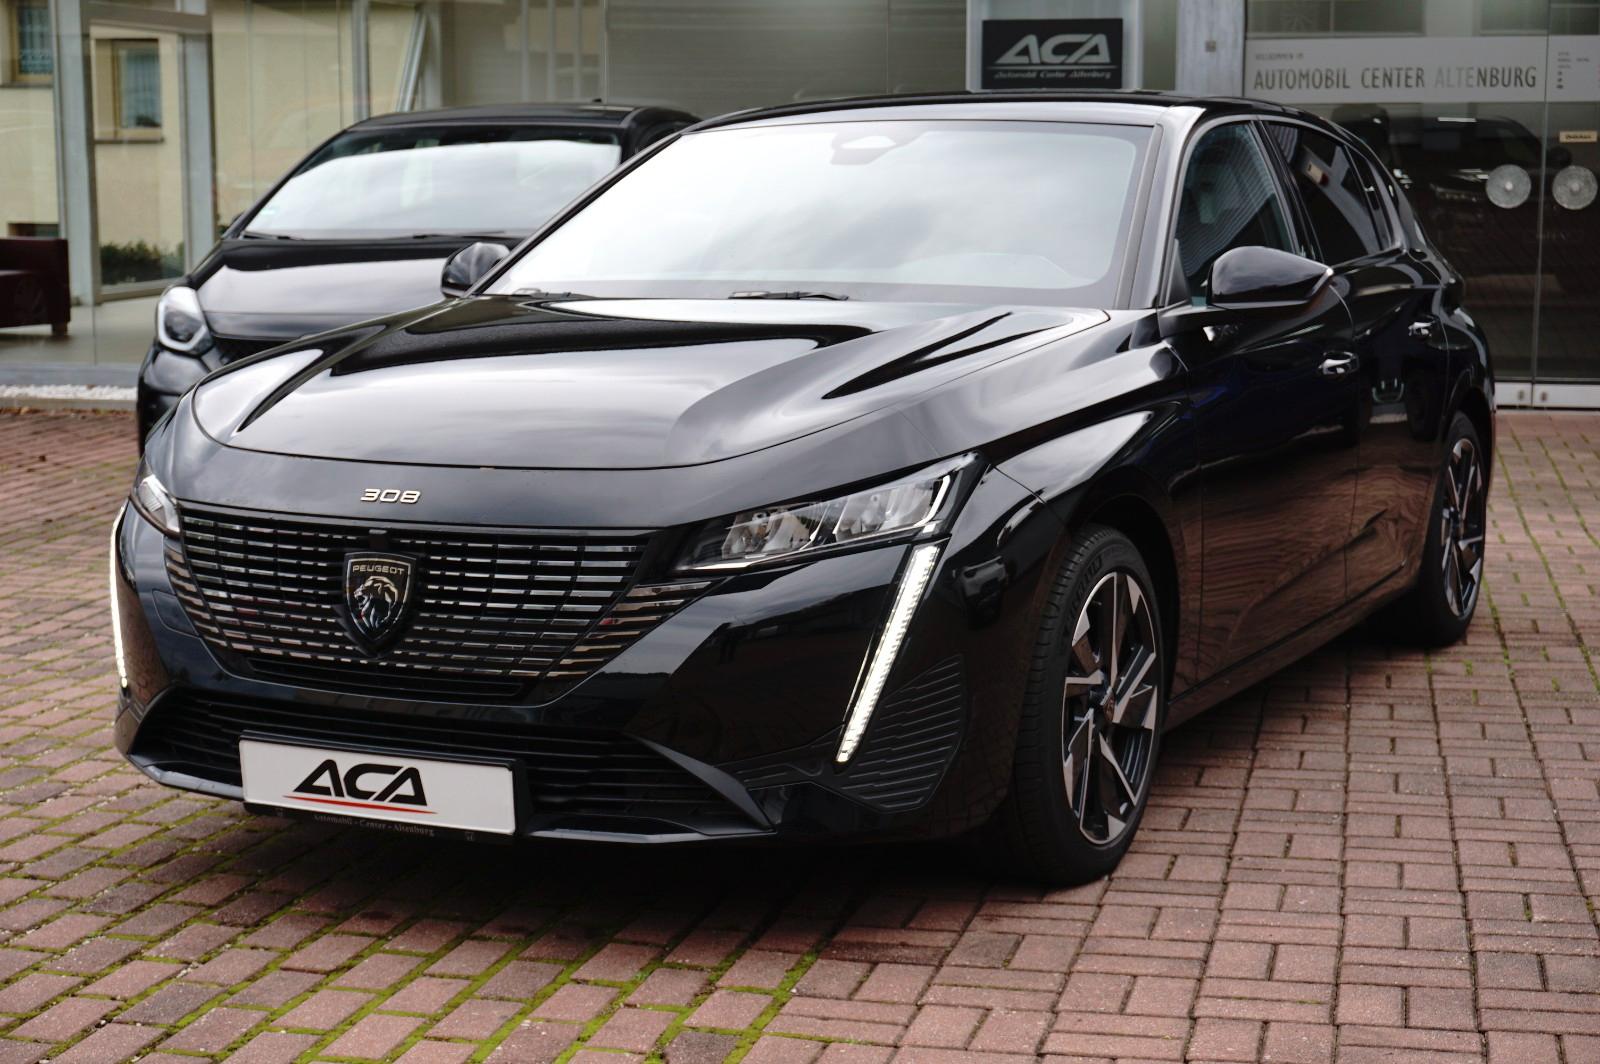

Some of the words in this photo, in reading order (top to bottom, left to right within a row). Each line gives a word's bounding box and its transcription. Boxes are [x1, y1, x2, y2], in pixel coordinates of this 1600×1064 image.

[994, 33, 1112, 65] ACA
[1254, 67, 1351, 90] AUTOMOBIL
[1361, 66, 1425, 89] CENTER
[1434, 66, 1537, 89] ALTENBURG
[360, 488, 422, 504] 308
[352, 564, 406, 574] PEUGEOT
[292, 759, 428, 807] ACA
